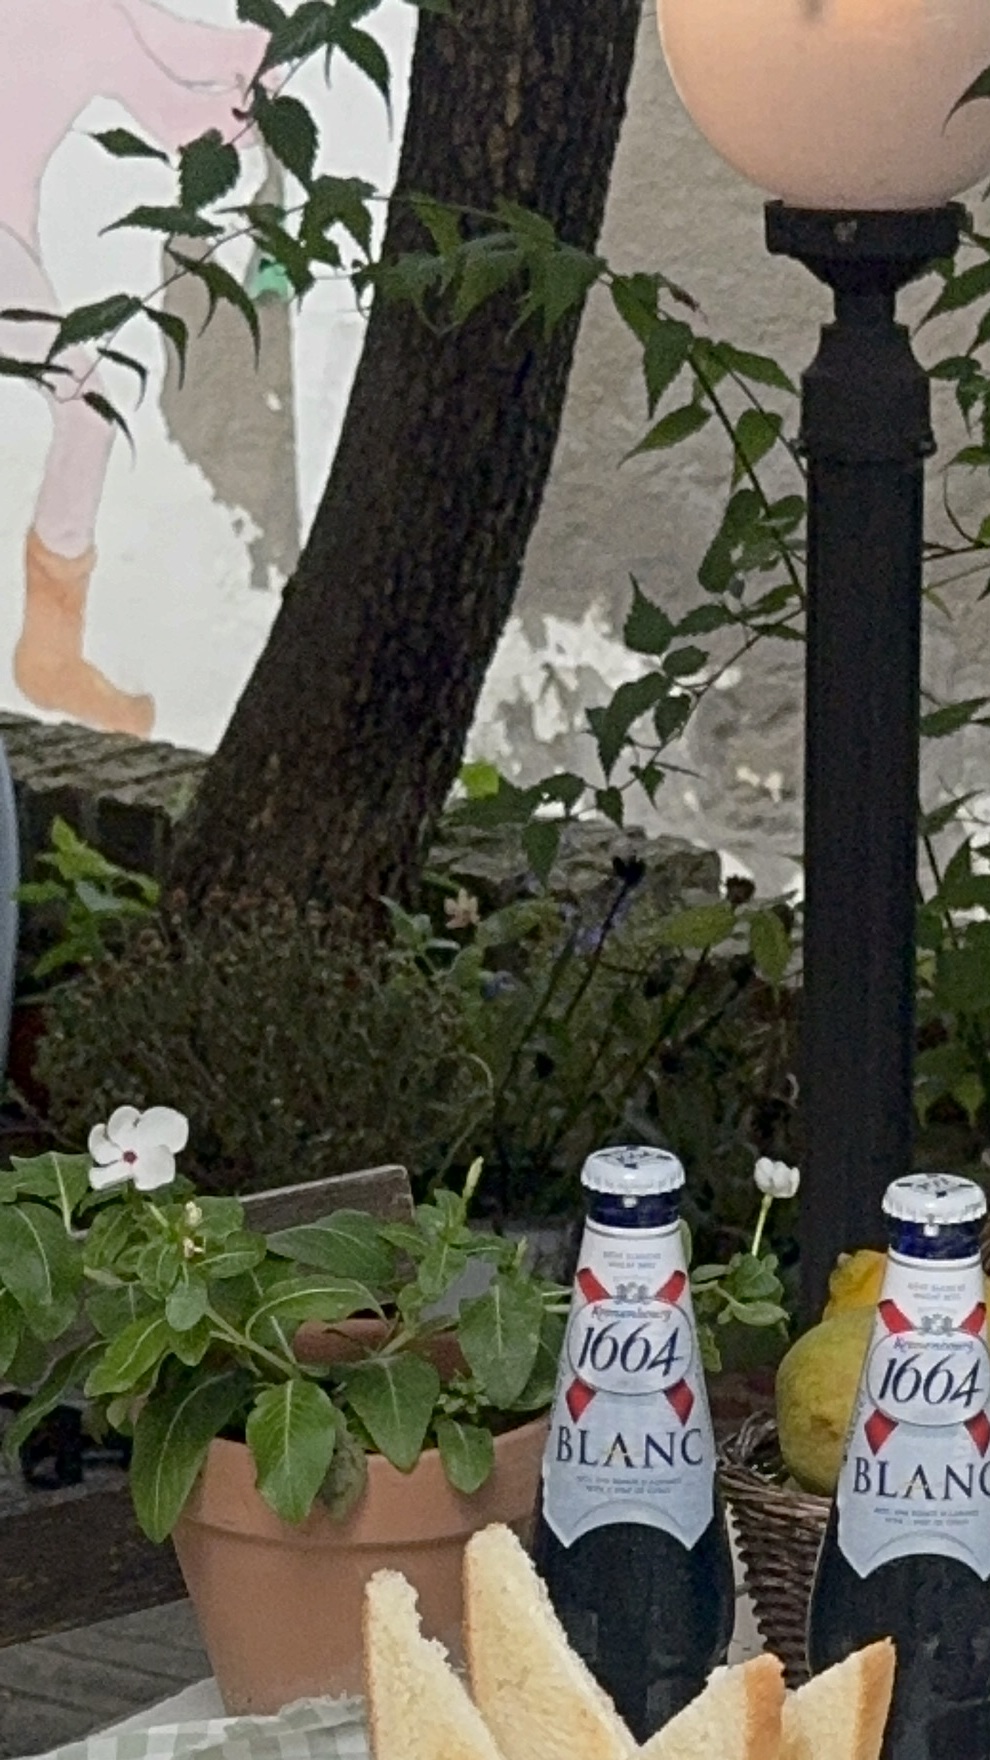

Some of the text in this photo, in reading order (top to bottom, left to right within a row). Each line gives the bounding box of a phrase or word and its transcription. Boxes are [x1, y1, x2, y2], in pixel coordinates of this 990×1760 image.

[578, 1320, 684, 1377] 1664
[878, 1352, 984, 1408] 1664
[556, 1425, 703, 1468] BLANC
